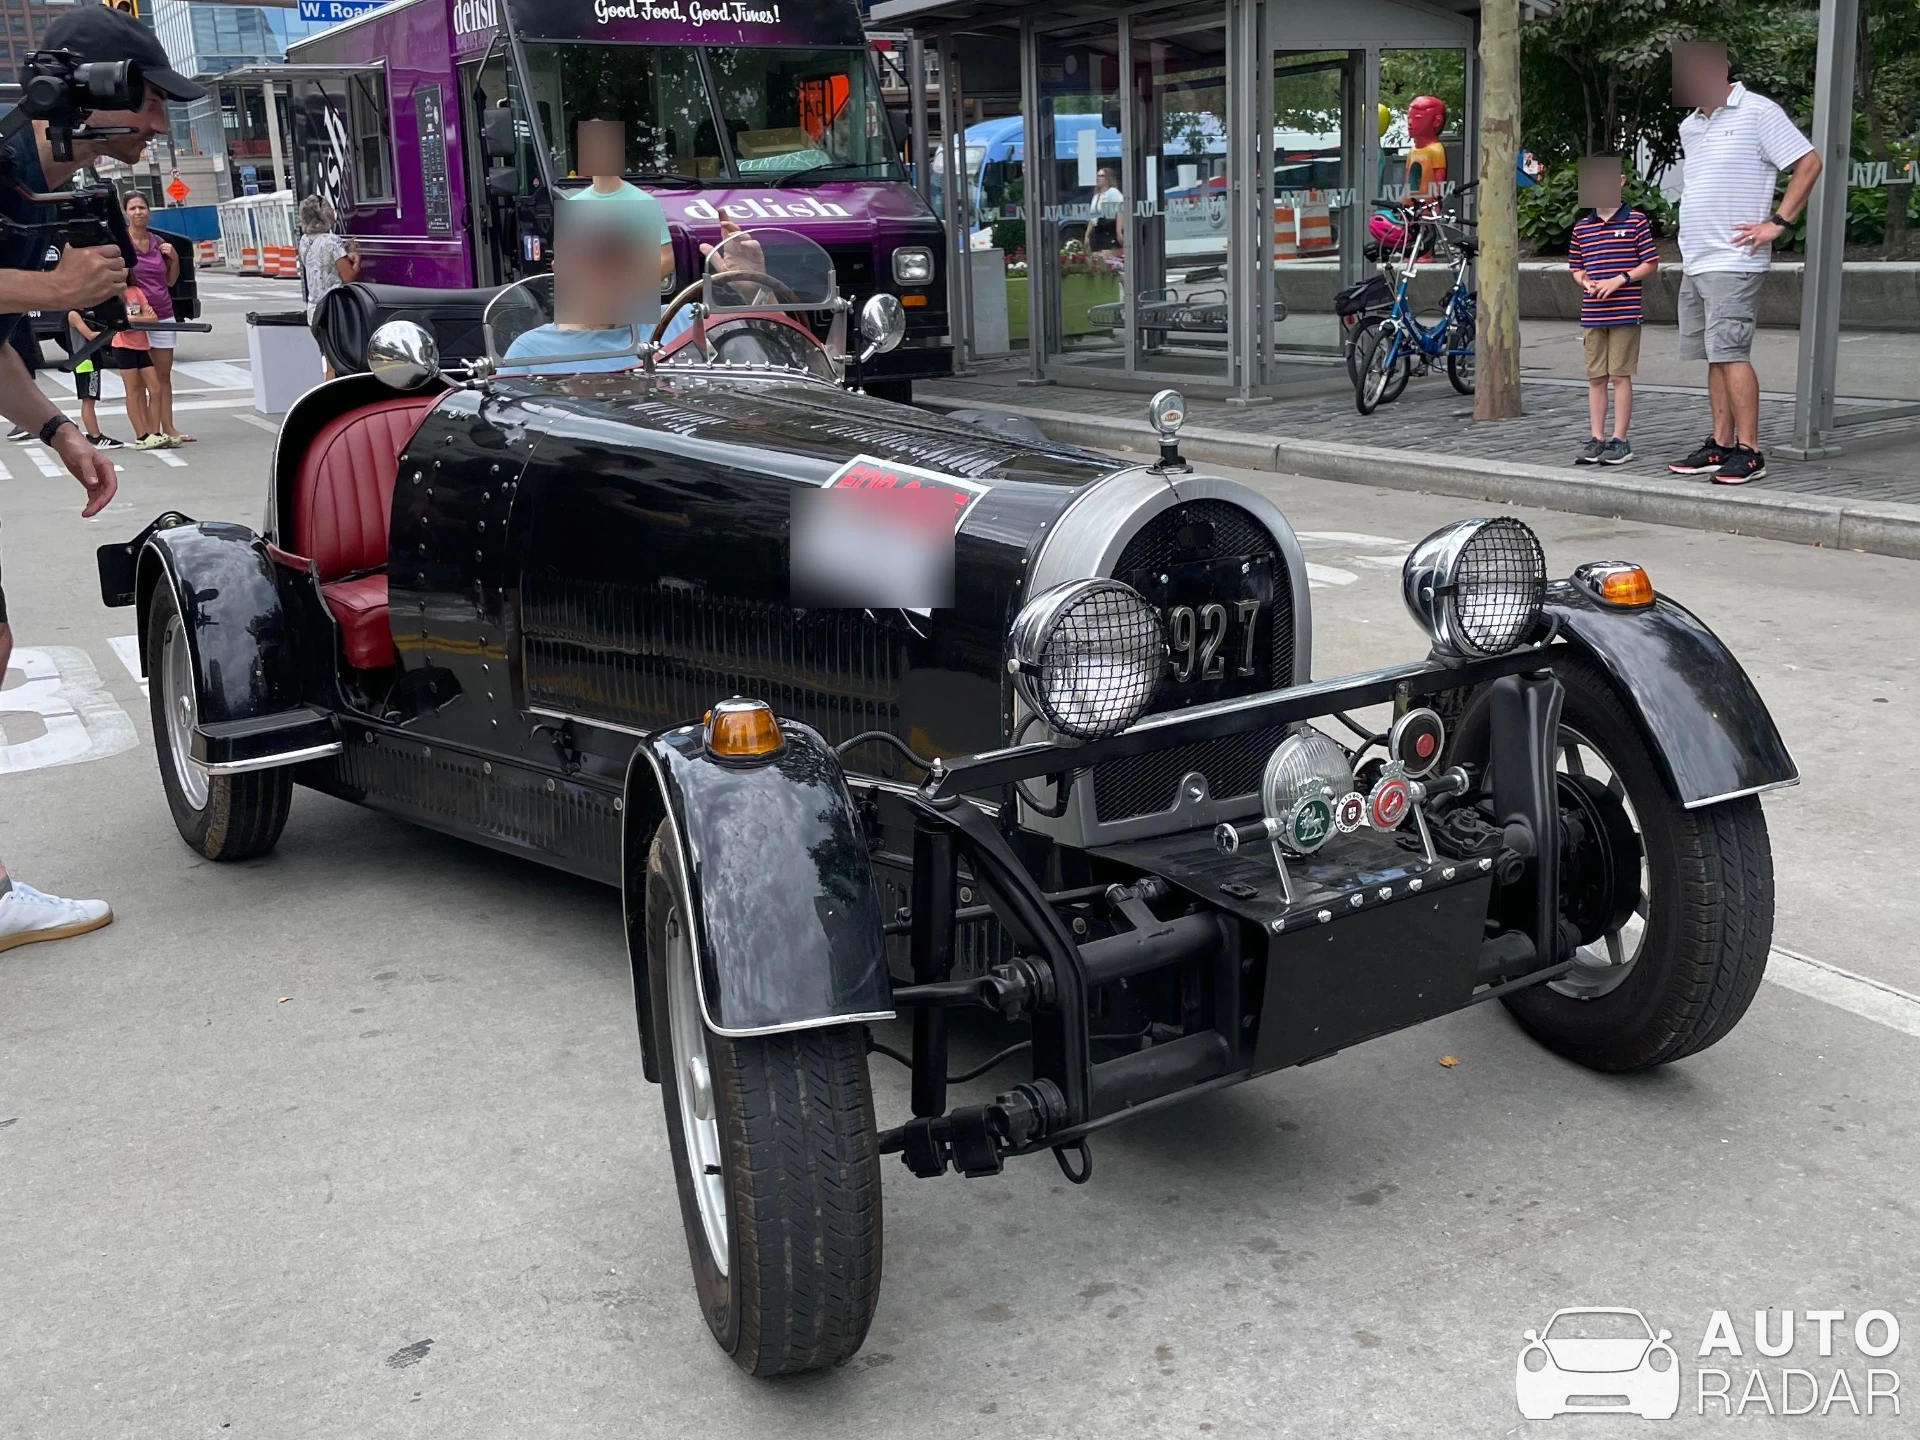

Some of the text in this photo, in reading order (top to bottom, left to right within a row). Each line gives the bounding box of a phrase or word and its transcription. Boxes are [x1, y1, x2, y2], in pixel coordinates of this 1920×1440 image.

[301, 2, 326, 18] W.
[594, 0, 781, 27] Good Food, Good Times!
[684, 197, 853, 220] delish
[1154, 599, 1260, 683] 927
